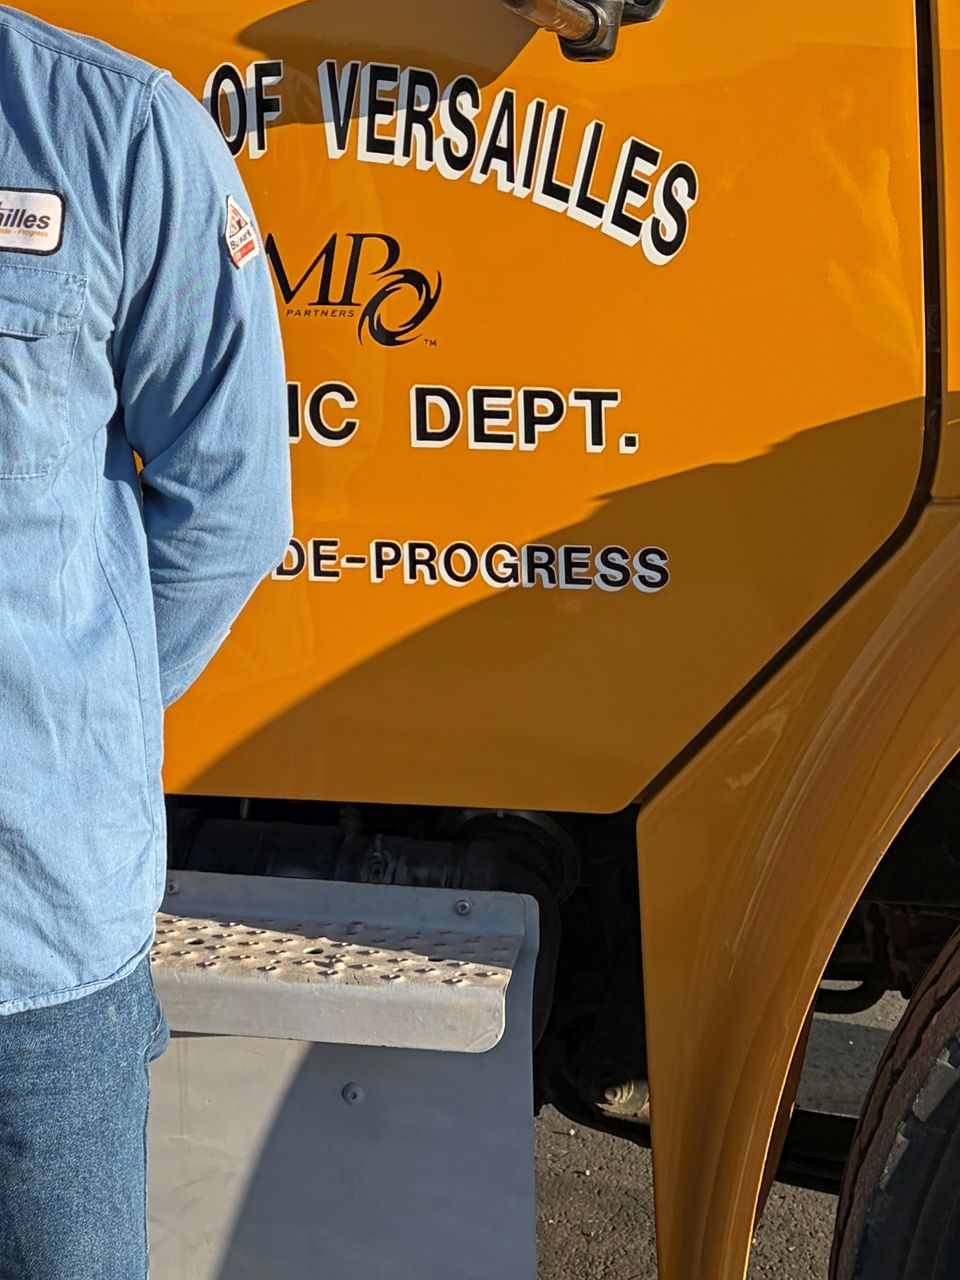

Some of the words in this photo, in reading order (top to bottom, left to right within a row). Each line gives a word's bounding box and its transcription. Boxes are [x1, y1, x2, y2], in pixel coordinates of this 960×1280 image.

[204, 59, 284, 160] OF
[318, 59, 698, 267] VERSAILLES
[286, 309, 355, 318] PARTNERS
[410, 384, 640, 454] DEPT.
[271, 538, 671, 593] DE-PROGRESS
